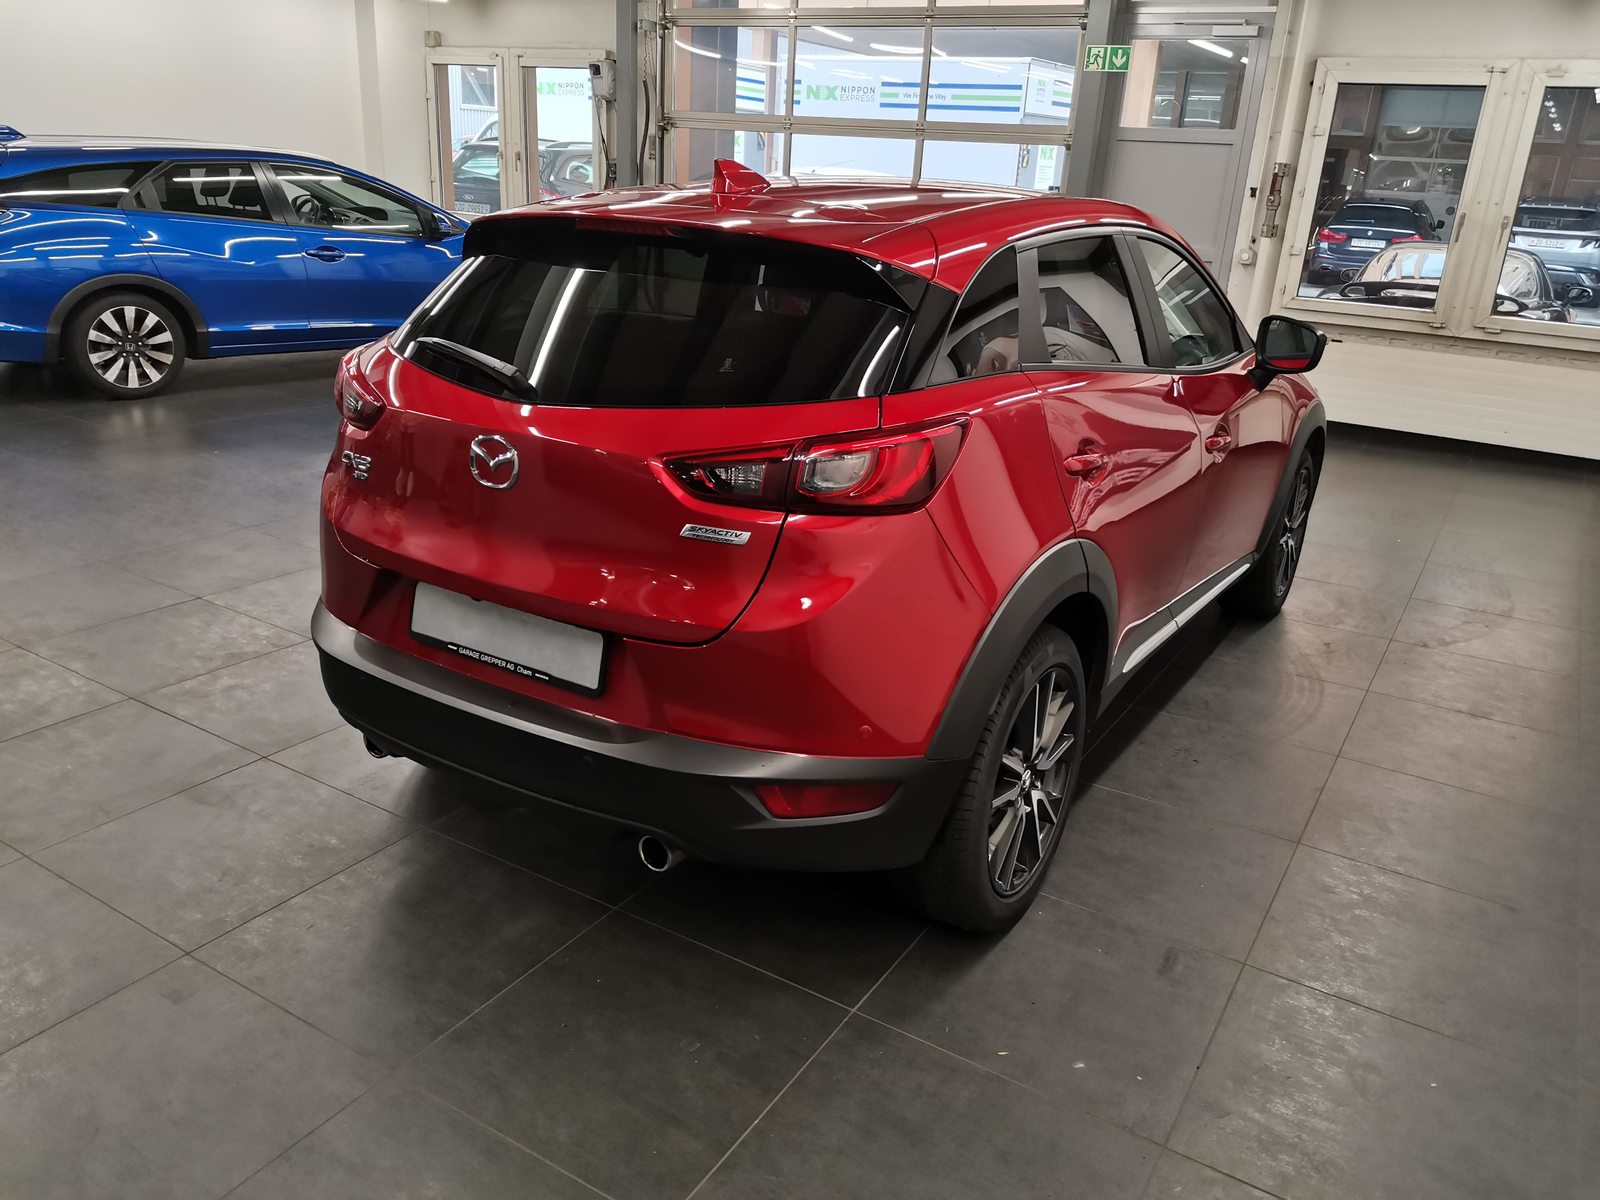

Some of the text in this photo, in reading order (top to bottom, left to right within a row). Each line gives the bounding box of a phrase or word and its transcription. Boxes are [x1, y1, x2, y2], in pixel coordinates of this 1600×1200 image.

[557, 82, 585, 90] NIPPON
[840, 85, 876, 95] NIPPON
[557, 89, 585, 97] EXPRESS
[806, 84, 841, 101] NX
[935, 93, 947, 101] Way
[839, 93, 876, 103] EXPRESS
[688, 525, 743, 539] SKYACTIV
[692, 534, 735, 544] TECHNOLOGY
[458, 647, 533, 677] GARAGE GREPPER AG Cham
